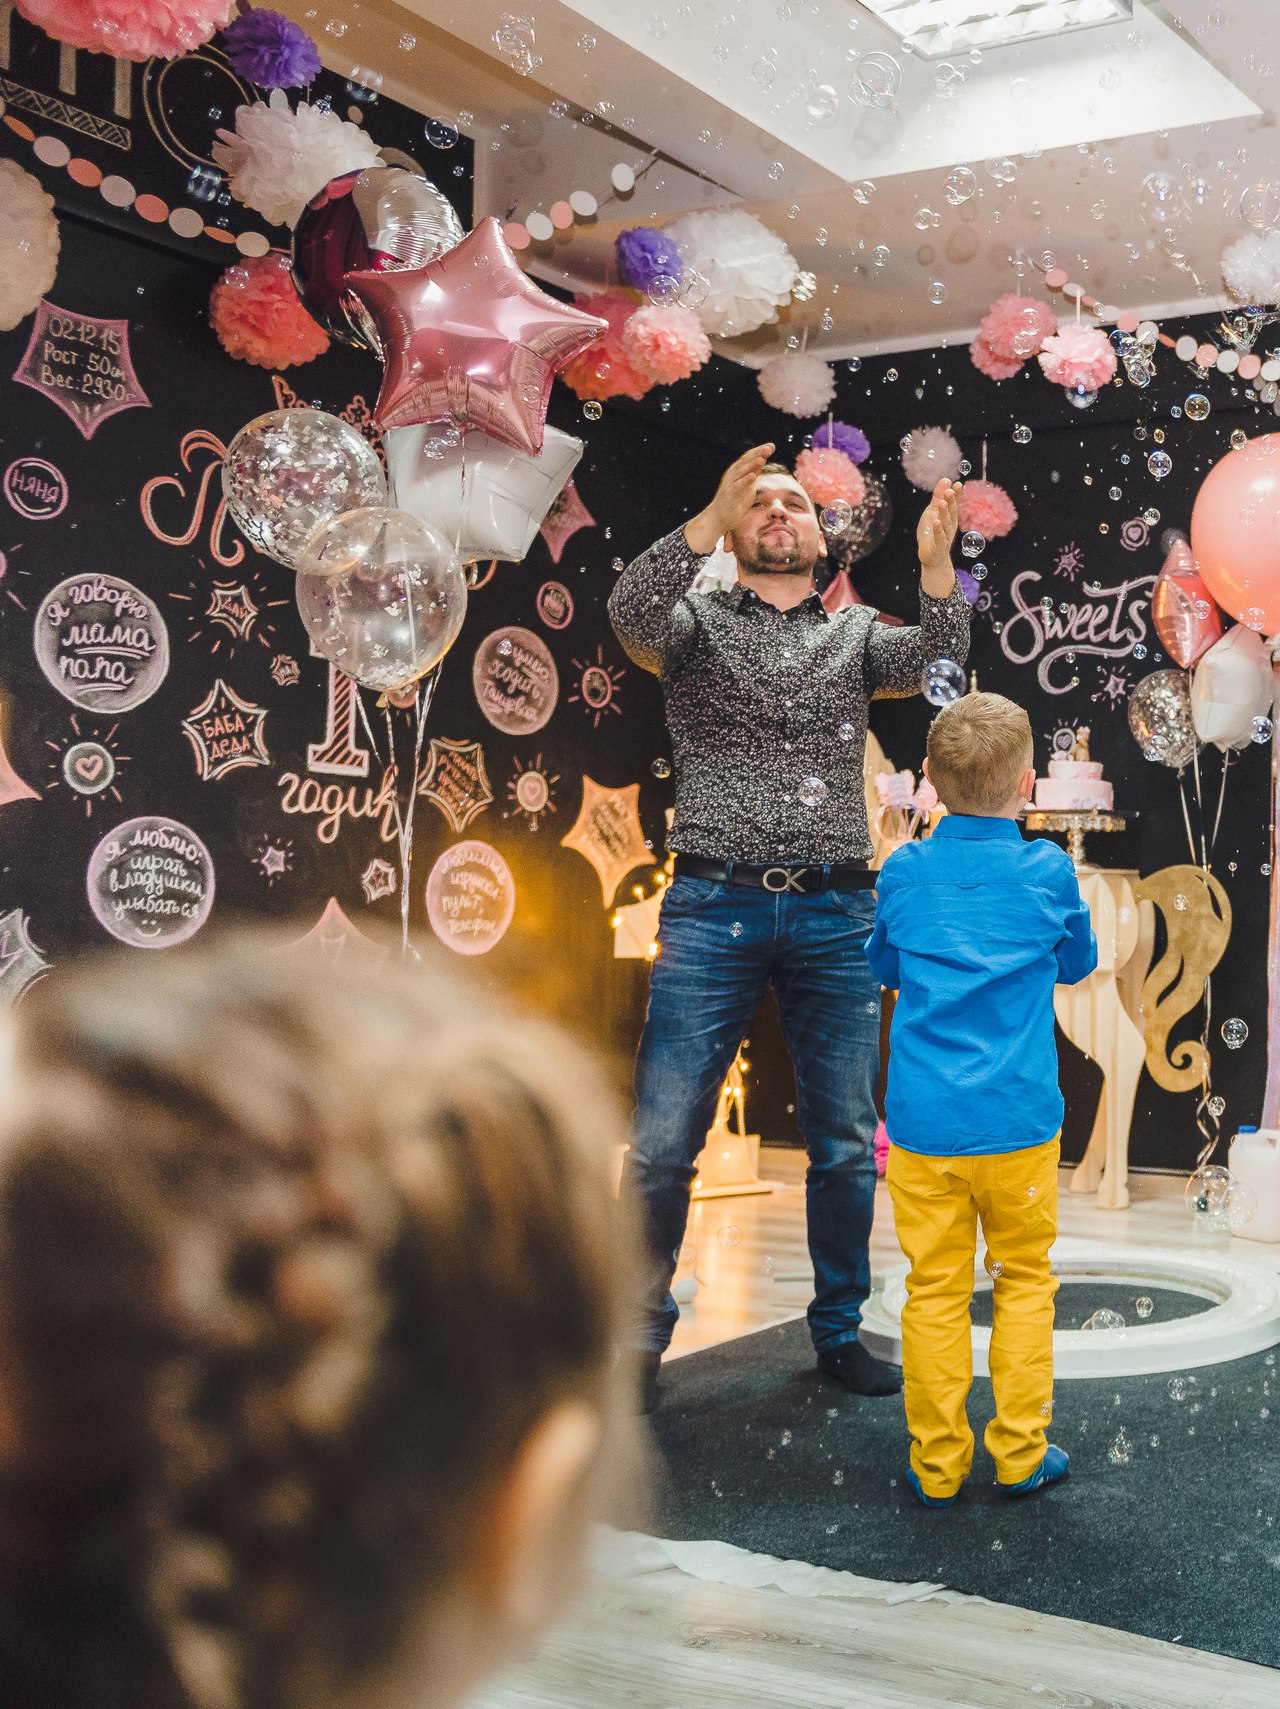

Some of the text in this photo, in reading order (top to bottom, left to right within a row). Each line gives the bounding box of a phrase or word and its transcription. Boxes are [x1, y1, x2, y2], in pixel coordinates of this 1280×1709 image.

[62, 623, 157, 651] мама
[1000, 570, 1159, 695] Sweets
[60, 656, 134, 685] папа
[202, 713, 246, 738] БАБА
[278, 757, 400, 843] годик
[130, 855, 187, 877] играть
[113, 894, 199, 921] улыбаться
